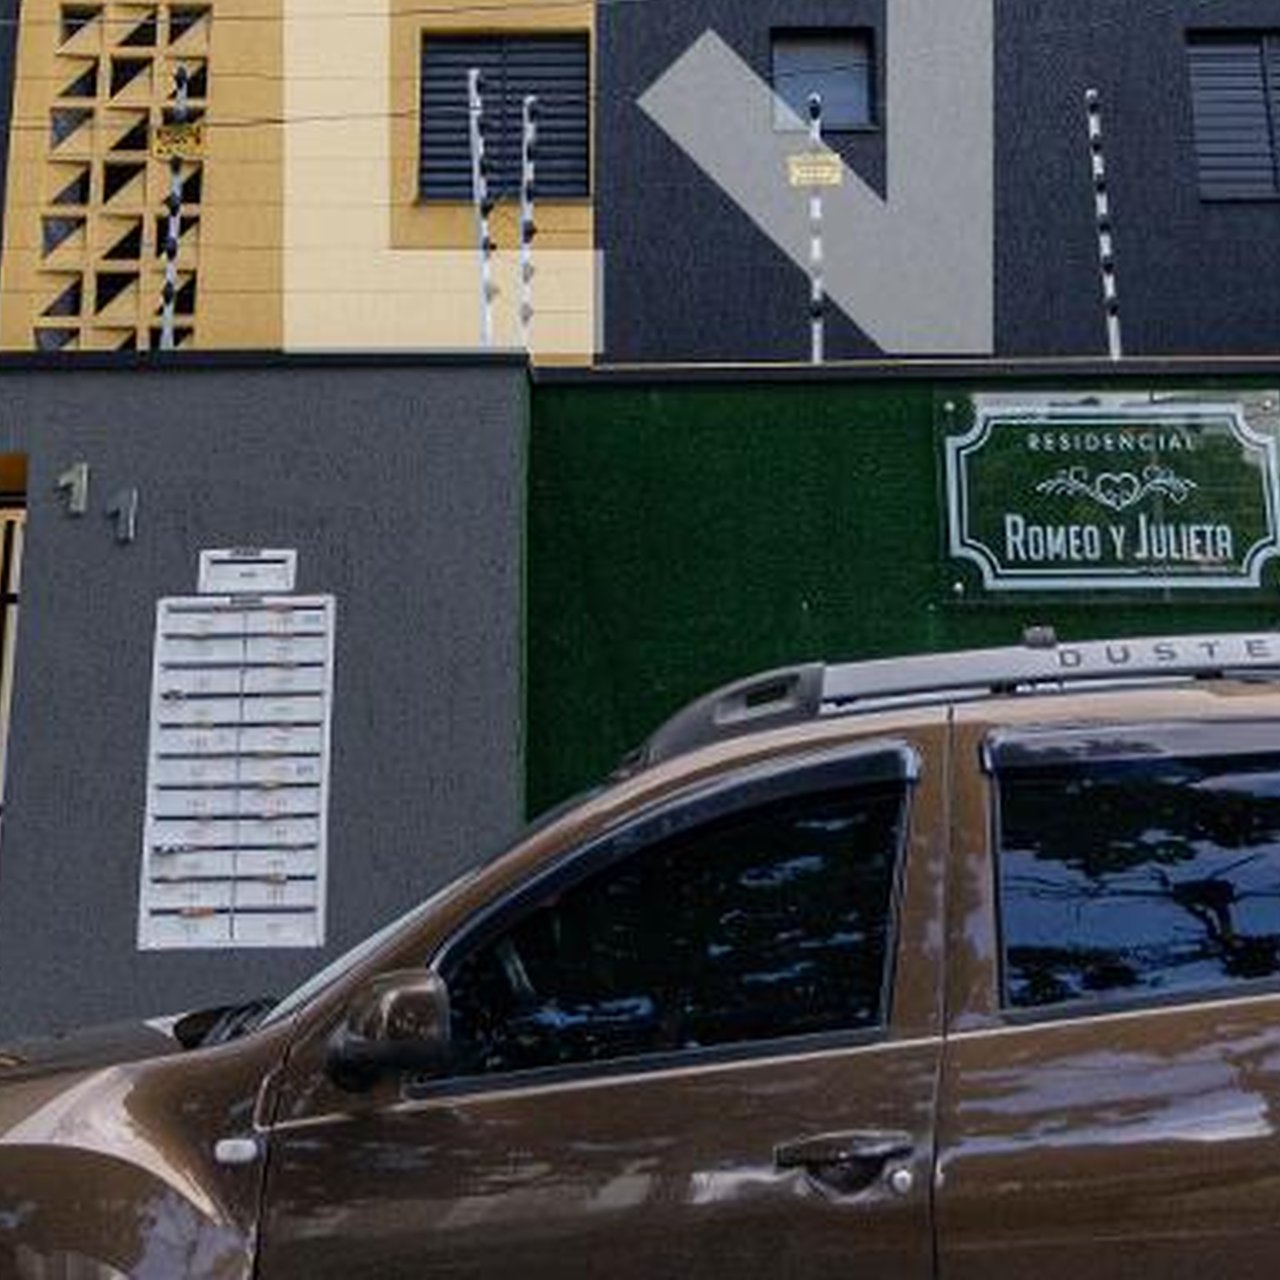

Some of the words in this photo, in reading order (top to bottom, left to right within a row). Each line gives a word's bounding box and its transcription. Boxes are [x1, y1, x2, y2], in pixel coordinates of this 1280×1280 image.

[1027, 432, 1195, 452] RESIDENCIAL
[1004, 513, 1102, 562] ROMEO
[1109, 525, 1125, 560] Y
[1134, 513, 1234, 560] JULIETA
